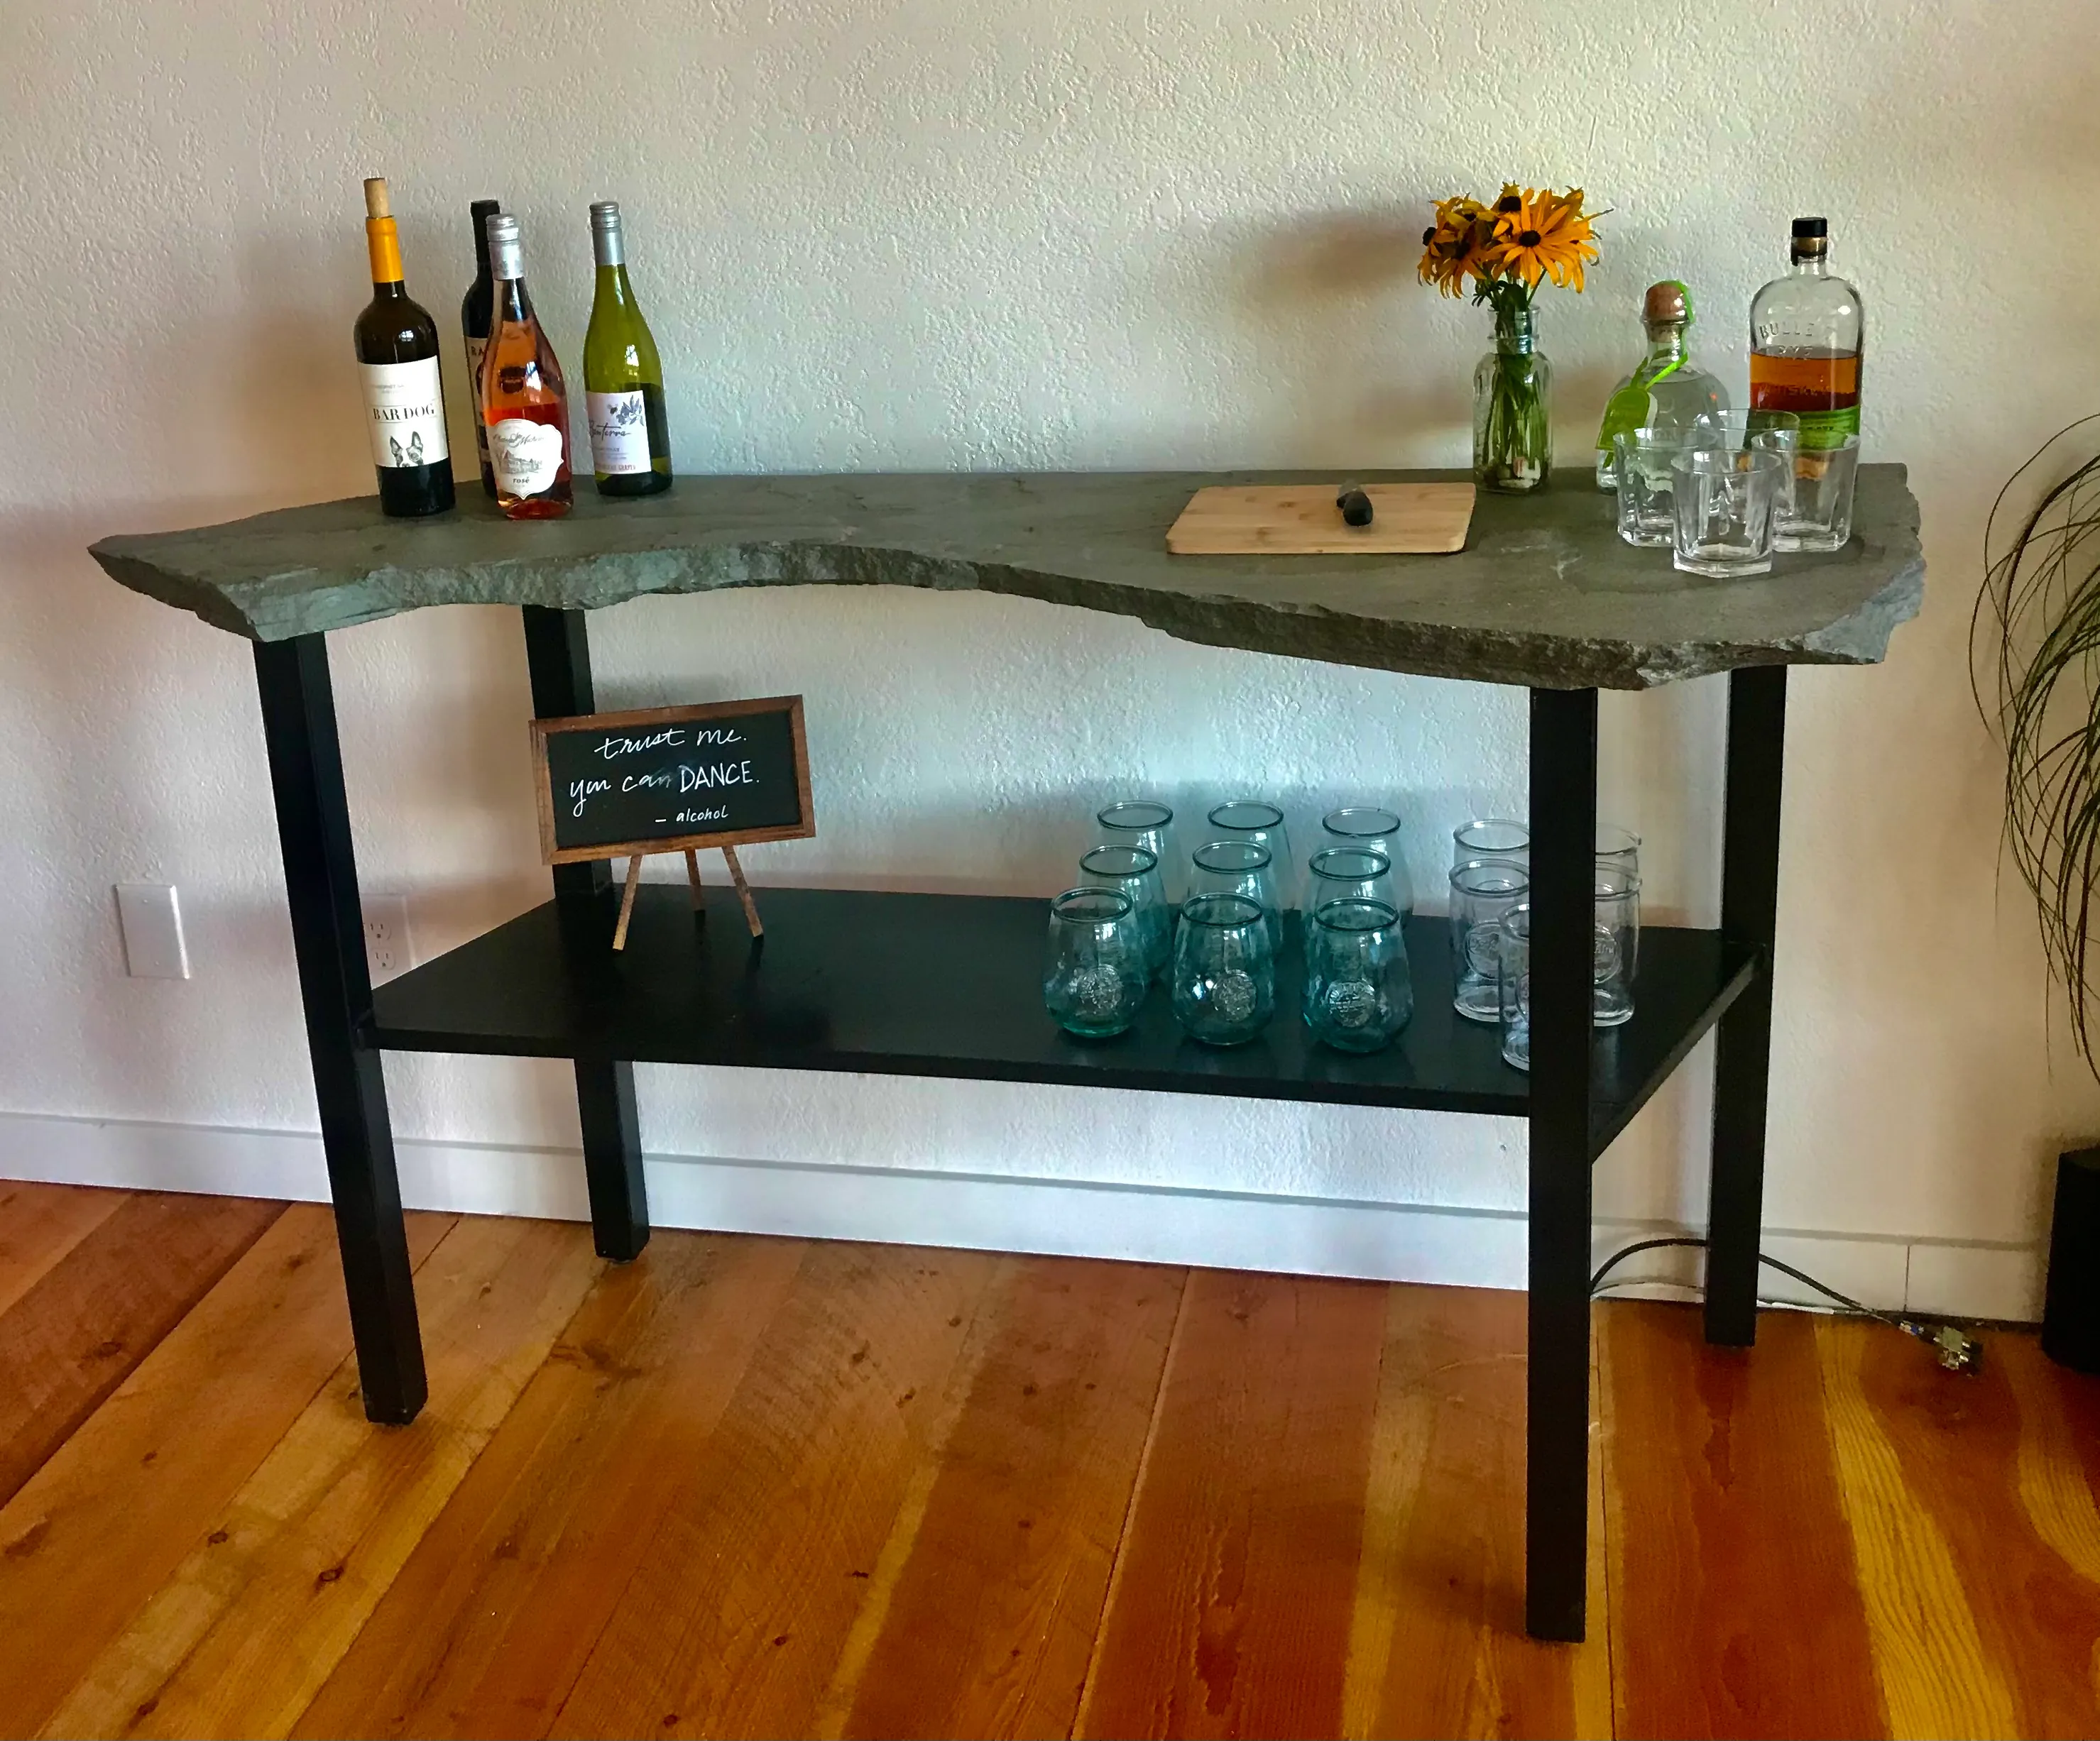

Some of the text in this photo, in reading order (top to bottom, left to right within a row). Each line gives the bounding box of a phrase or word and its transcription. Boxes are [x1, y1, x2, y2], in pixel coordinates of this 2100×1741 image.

[373, 403, 434, 421] BAR DOG
[513, 476, 530, 484] rosé
[594, 727, 747, 759] trust me.
[569, 760, 760, 818] you can DANCE.
[676, 804, 729, 823] alcohol
